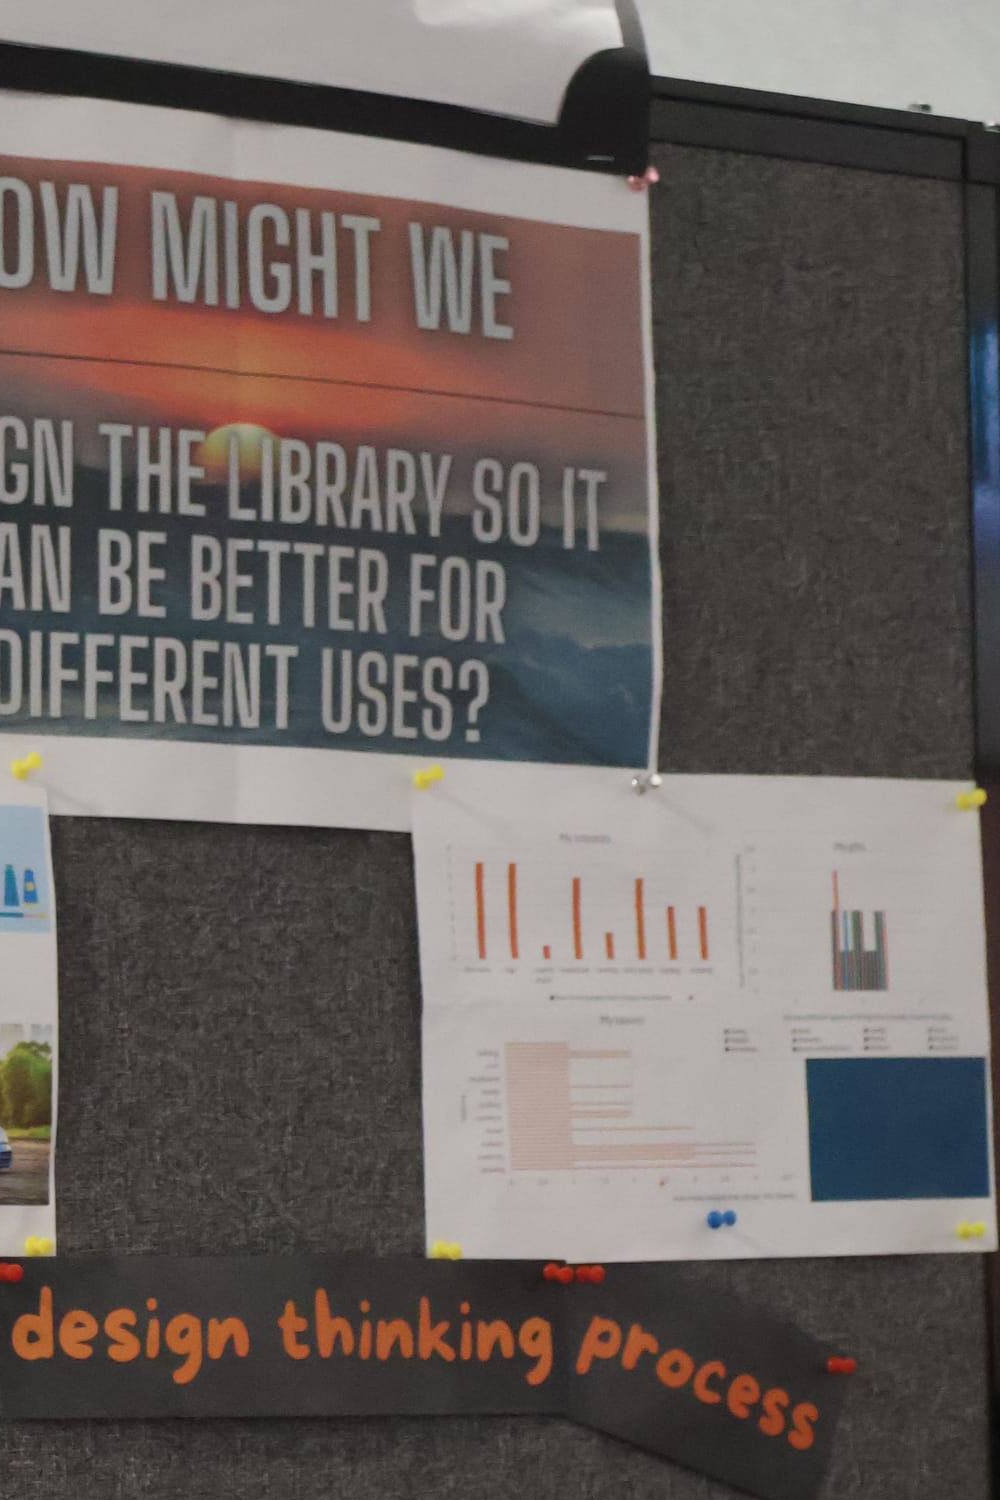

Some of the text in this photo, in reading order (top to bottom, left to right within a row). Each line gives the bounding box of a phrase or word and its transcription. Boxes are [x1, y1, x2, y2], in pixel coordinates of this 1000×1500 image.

[150, 190, 381, 322] MIGHT
[407, 221, 515, 340] WE
[98, 421, 207, 518] THE
[227, 436, 452, 536] LIBRARY
[471, 457, 540, 547] SO
[560, 467, 608, 552] IT
[97, 530, 167, 618] BE
[189, 539, 388, 635] BETTER
[408, 552, 507, 644] FOR
[320, 647, 490, 743] USES?
[11, 1285, 250, 1385] design
[277, 1288, 552, 1385] thinking
[574, 1315, 819, 1451] process
